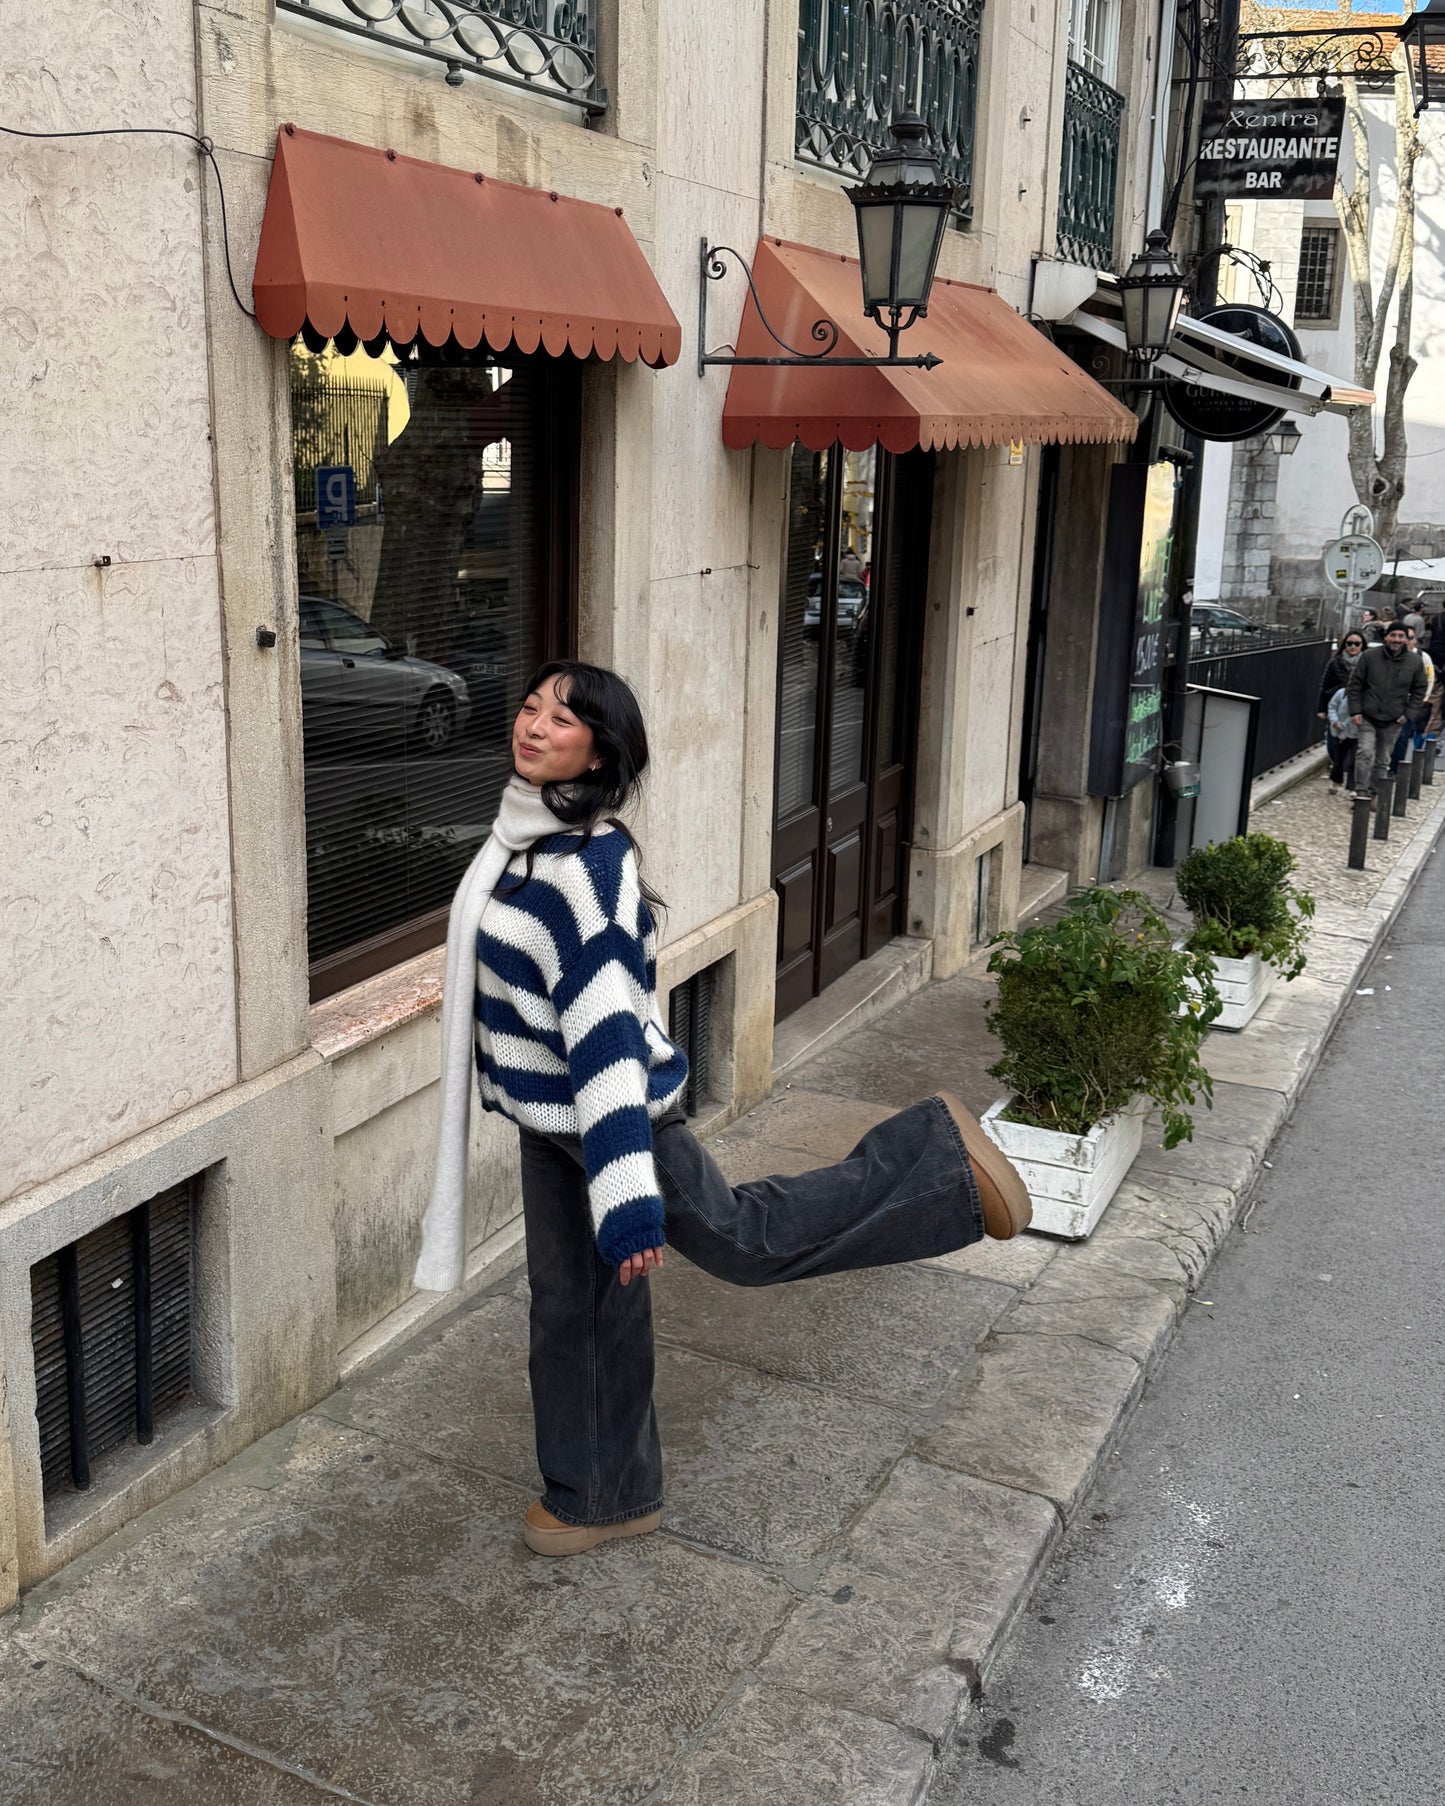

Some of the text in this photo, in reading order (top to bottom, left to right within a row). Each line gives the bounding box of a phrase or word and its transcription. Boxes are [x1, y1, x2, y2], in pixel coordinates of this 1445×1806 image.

[1226, 110, 1319, 129] Xentra
[1201, 137, 1339, 160] RESTAURANTE
[1246, 172, 1282, 189] BAR
